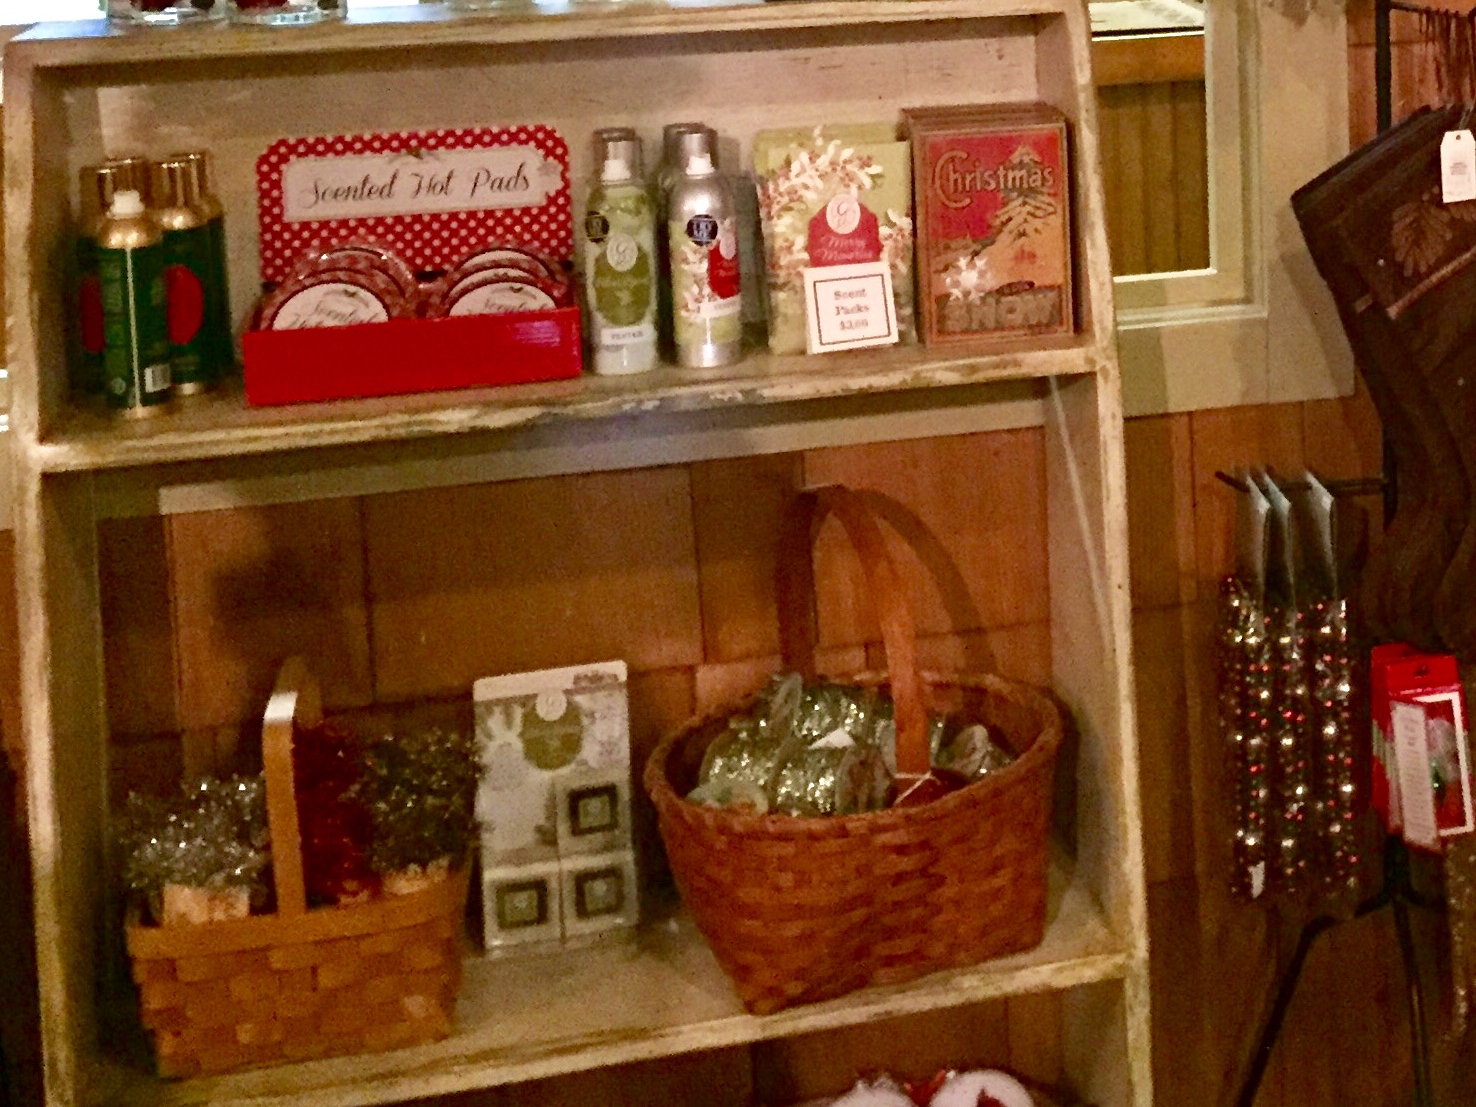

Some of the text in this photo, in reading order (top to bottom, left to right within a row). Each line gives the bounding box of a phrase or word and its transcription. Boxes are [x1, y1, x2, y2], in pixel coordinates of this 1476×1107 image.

[300, 161, 530, 210] Scented Hot Pads
[934, 148, 1055, 210] Christmas
